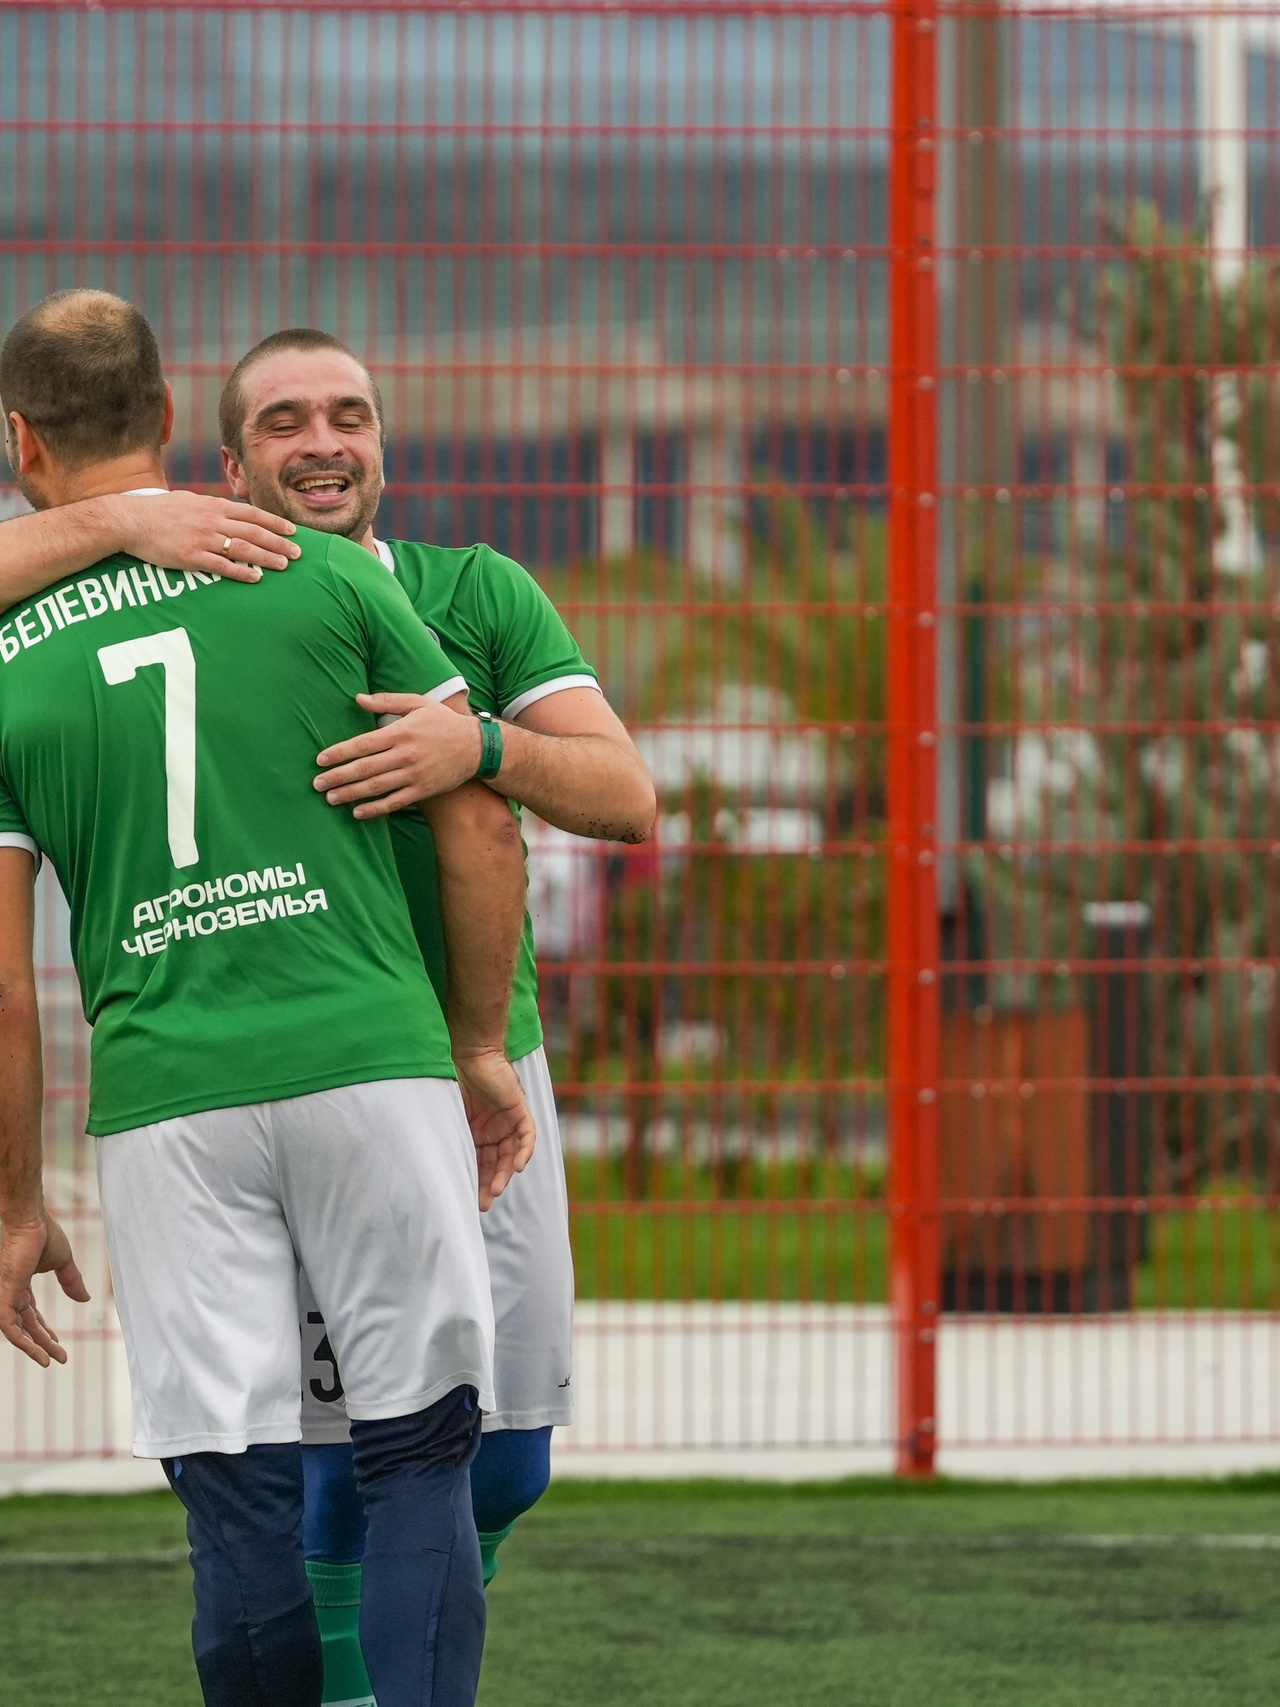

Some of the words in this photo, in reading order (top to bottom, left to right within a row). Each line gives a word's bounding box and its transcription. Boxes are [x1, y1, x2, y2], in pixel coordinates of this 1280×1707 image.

[97, 627, 200, 869] 7
[121, 888, 329, 958] ЧЕРНОЗЕМЬЯ
[133, 862, 307, 929] АГРОНОМЫ
[299, 1311, 345, 1403] 3
